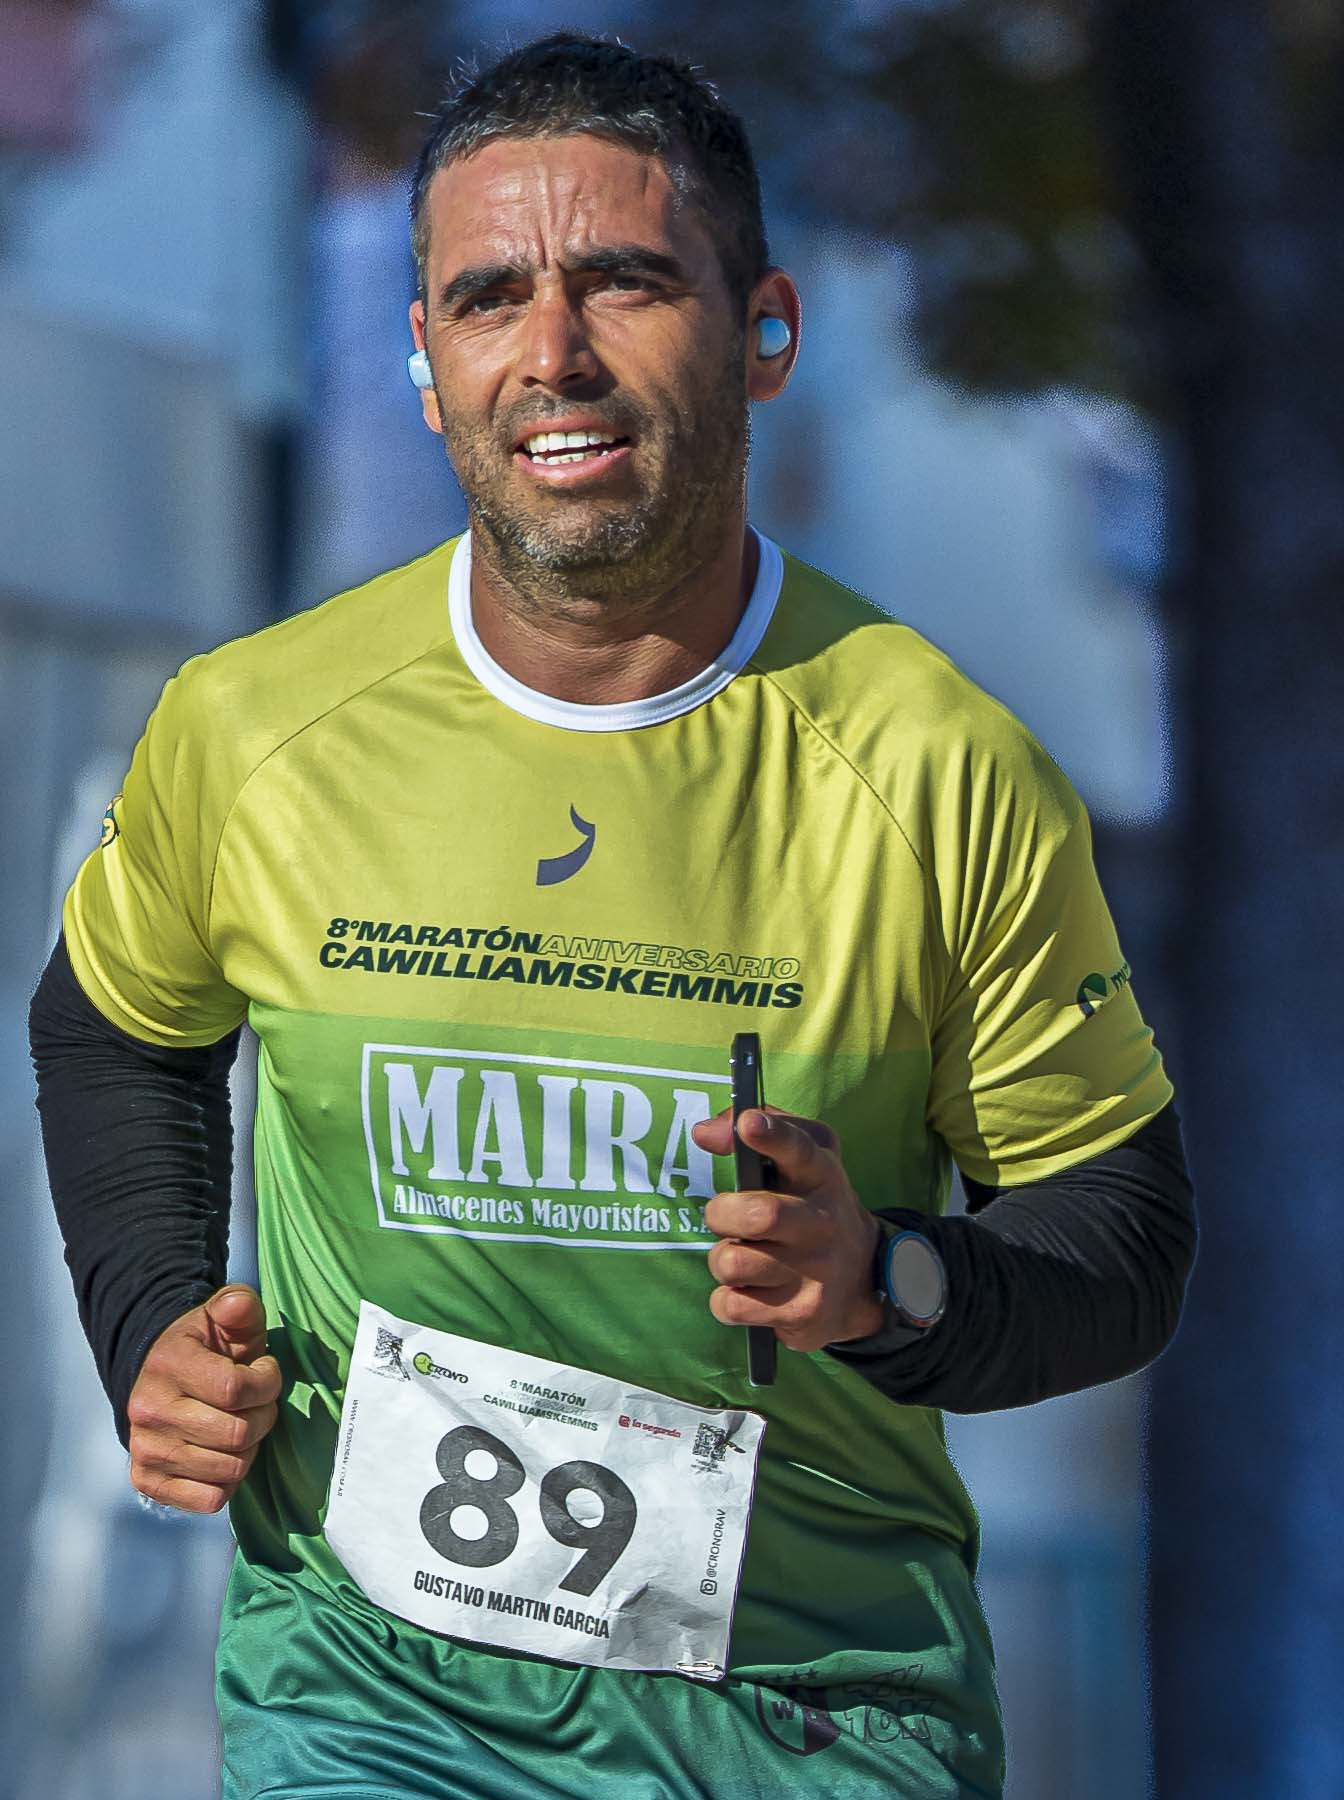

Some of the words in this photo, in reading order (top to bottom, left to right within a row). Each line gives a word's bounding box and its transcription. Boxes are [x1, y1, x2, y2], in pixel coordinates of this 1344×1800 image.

[318, 941, 805, 1009] CAWILLIAMSKEMMIS
[383, 1062, 716, 1198] MAIRA
[392, 1183, 524, 1224] Almacenes
[531, 1198, 670, 1234] Mayoristas
[419, 1424, 638, 1597] 89
[706, 1508, 727, 1578] @CRONORAV
[413, 1570, 485, 1608] GUSTAVO
[486, 1590, 551, 1623] MARTIN
[552, 1605, 610, 1639] GARCIA
